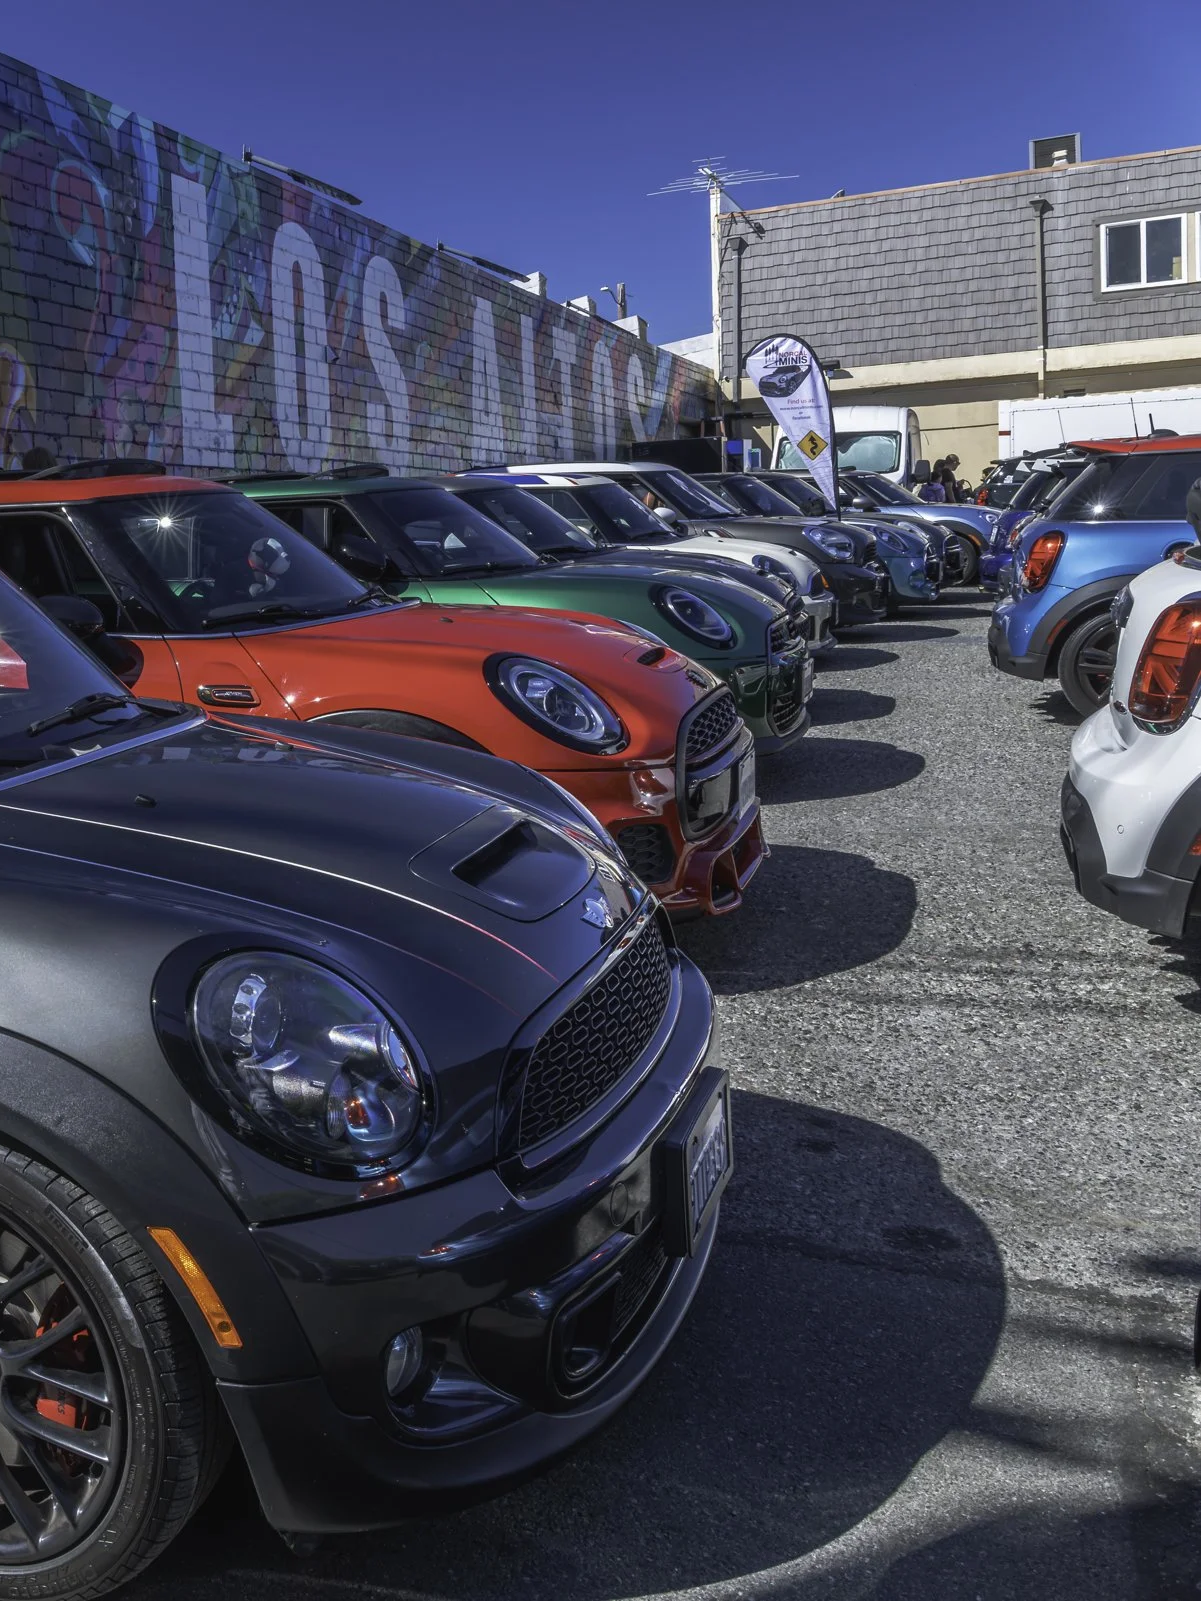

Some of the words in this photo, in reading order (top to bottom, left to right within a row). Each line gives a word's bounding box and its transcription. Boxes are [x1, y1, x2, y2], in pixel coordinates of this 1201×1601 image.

[171, 173, 410, 478] LOS
[778, 350, 807, 358] NORCAL
[778, 356, 808, 366] MINIS
[43, 1204, 88, 1255] PIRELLI
